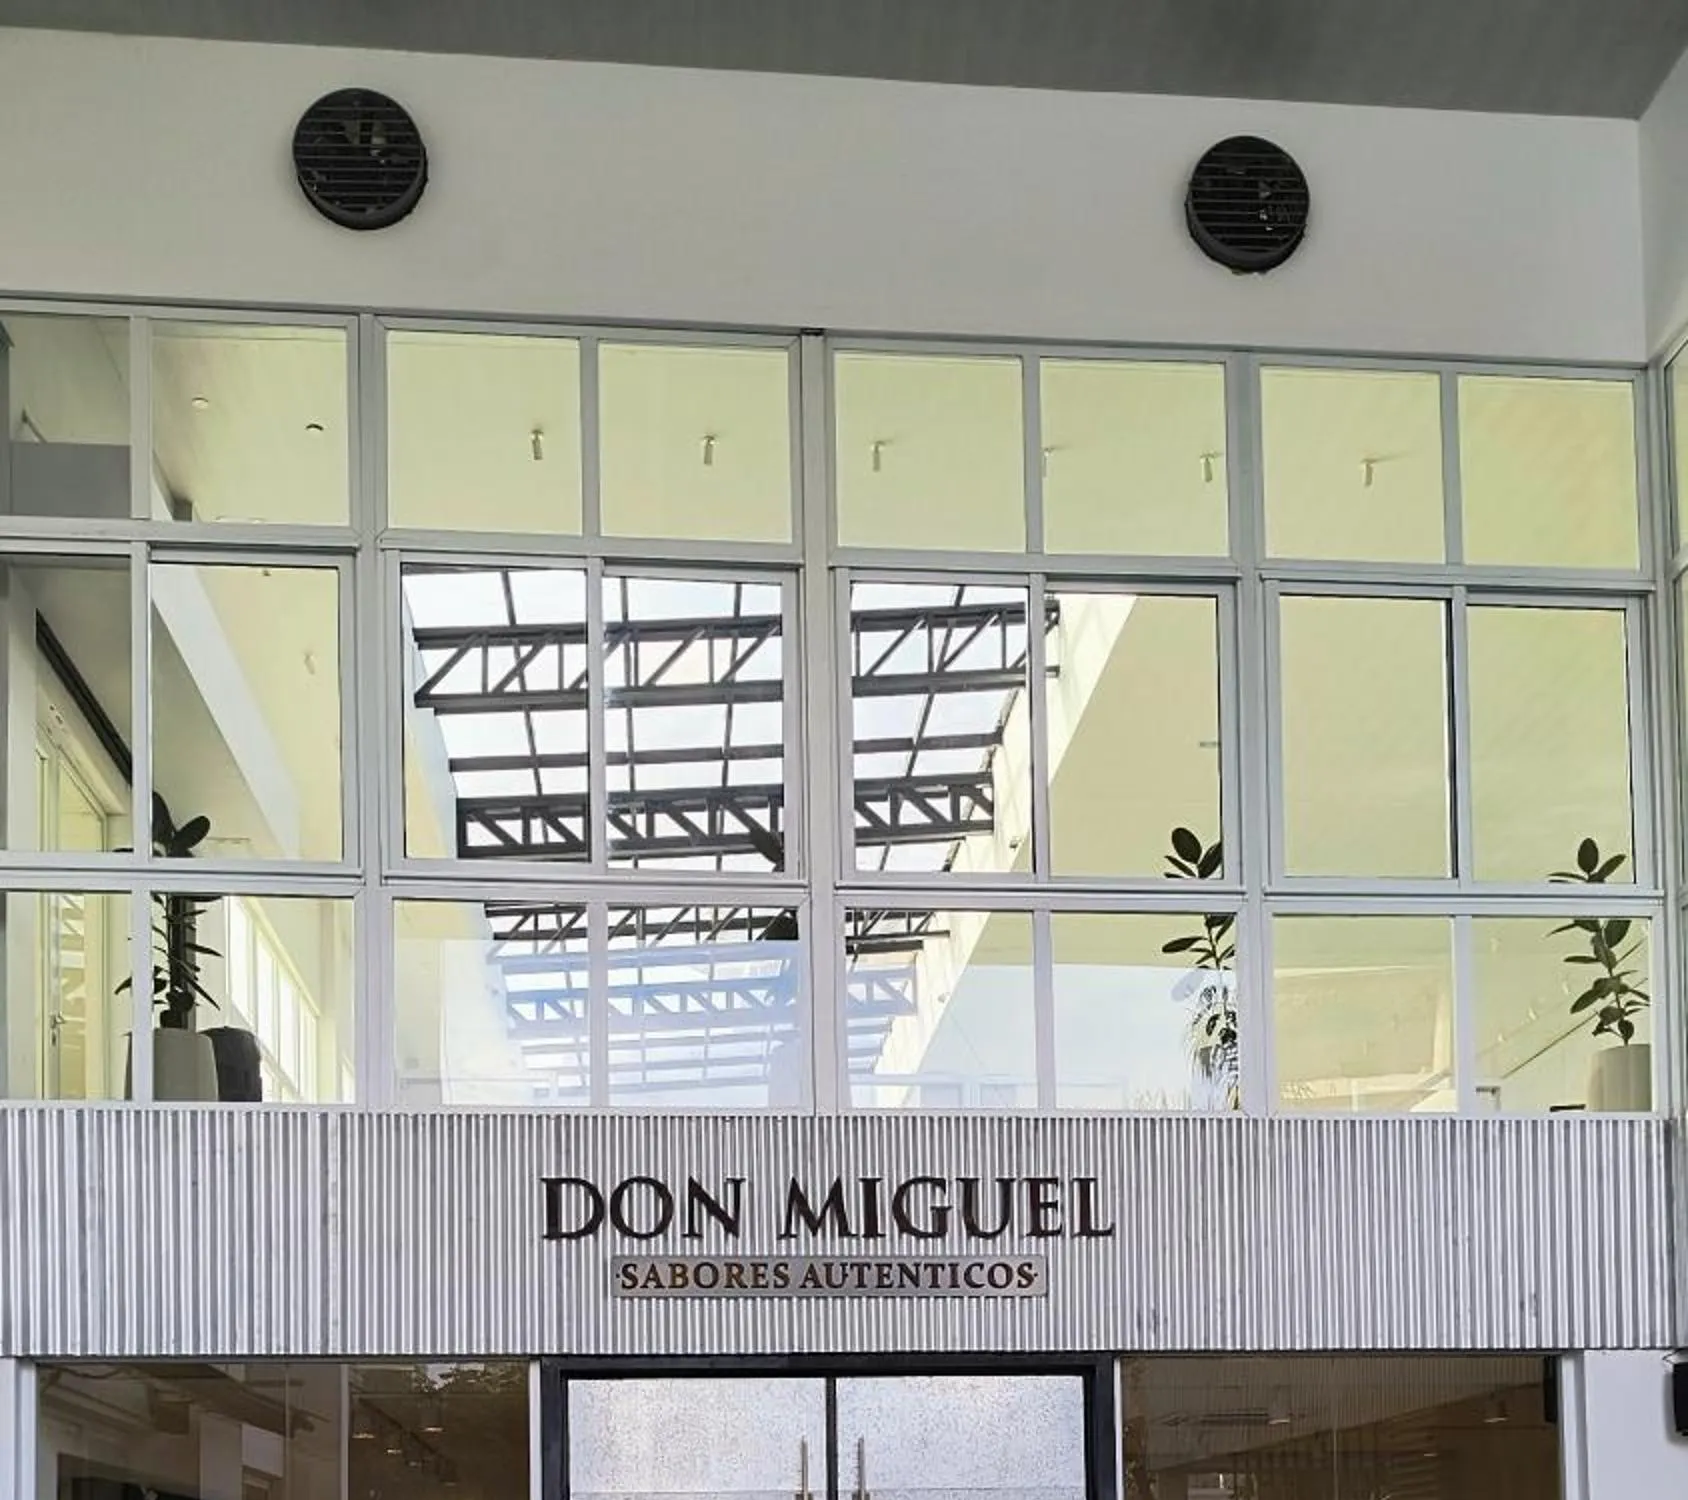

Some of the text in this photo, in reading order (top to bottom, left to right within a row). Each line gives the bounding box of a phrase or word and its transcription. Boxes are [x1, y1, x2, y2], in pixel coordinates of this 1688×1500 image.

[540, 1176, 1115, 1240] DON MIGUEL
[620, 1262, 790, 1289] SABORES
